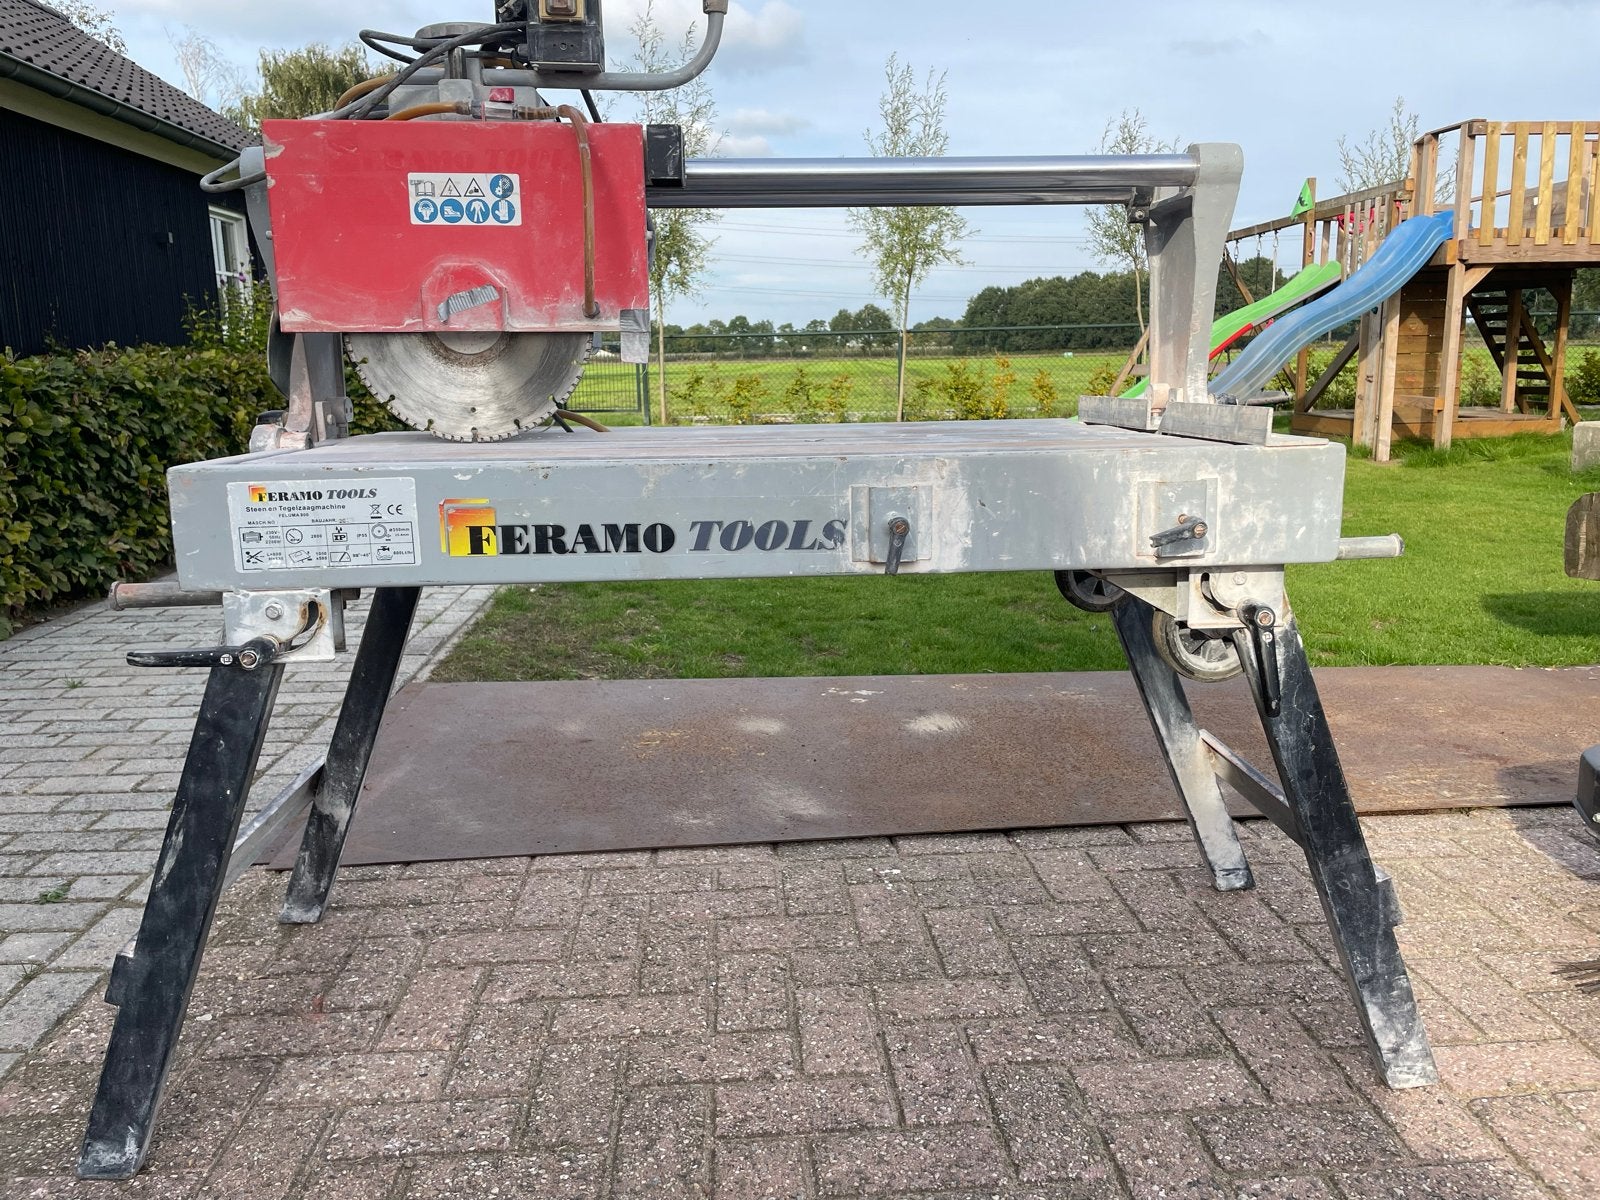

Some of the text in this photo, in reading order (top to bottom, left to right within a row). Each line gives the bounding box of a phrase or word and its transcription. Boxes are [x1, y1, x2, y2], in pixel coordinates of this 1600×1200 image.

[258, 488, 378, 503] FERAMO TOOLS
[278, 504, 346, 513] Tegelzaagmachine
[465, 518, 849, 556] FERAMO TOOLS
